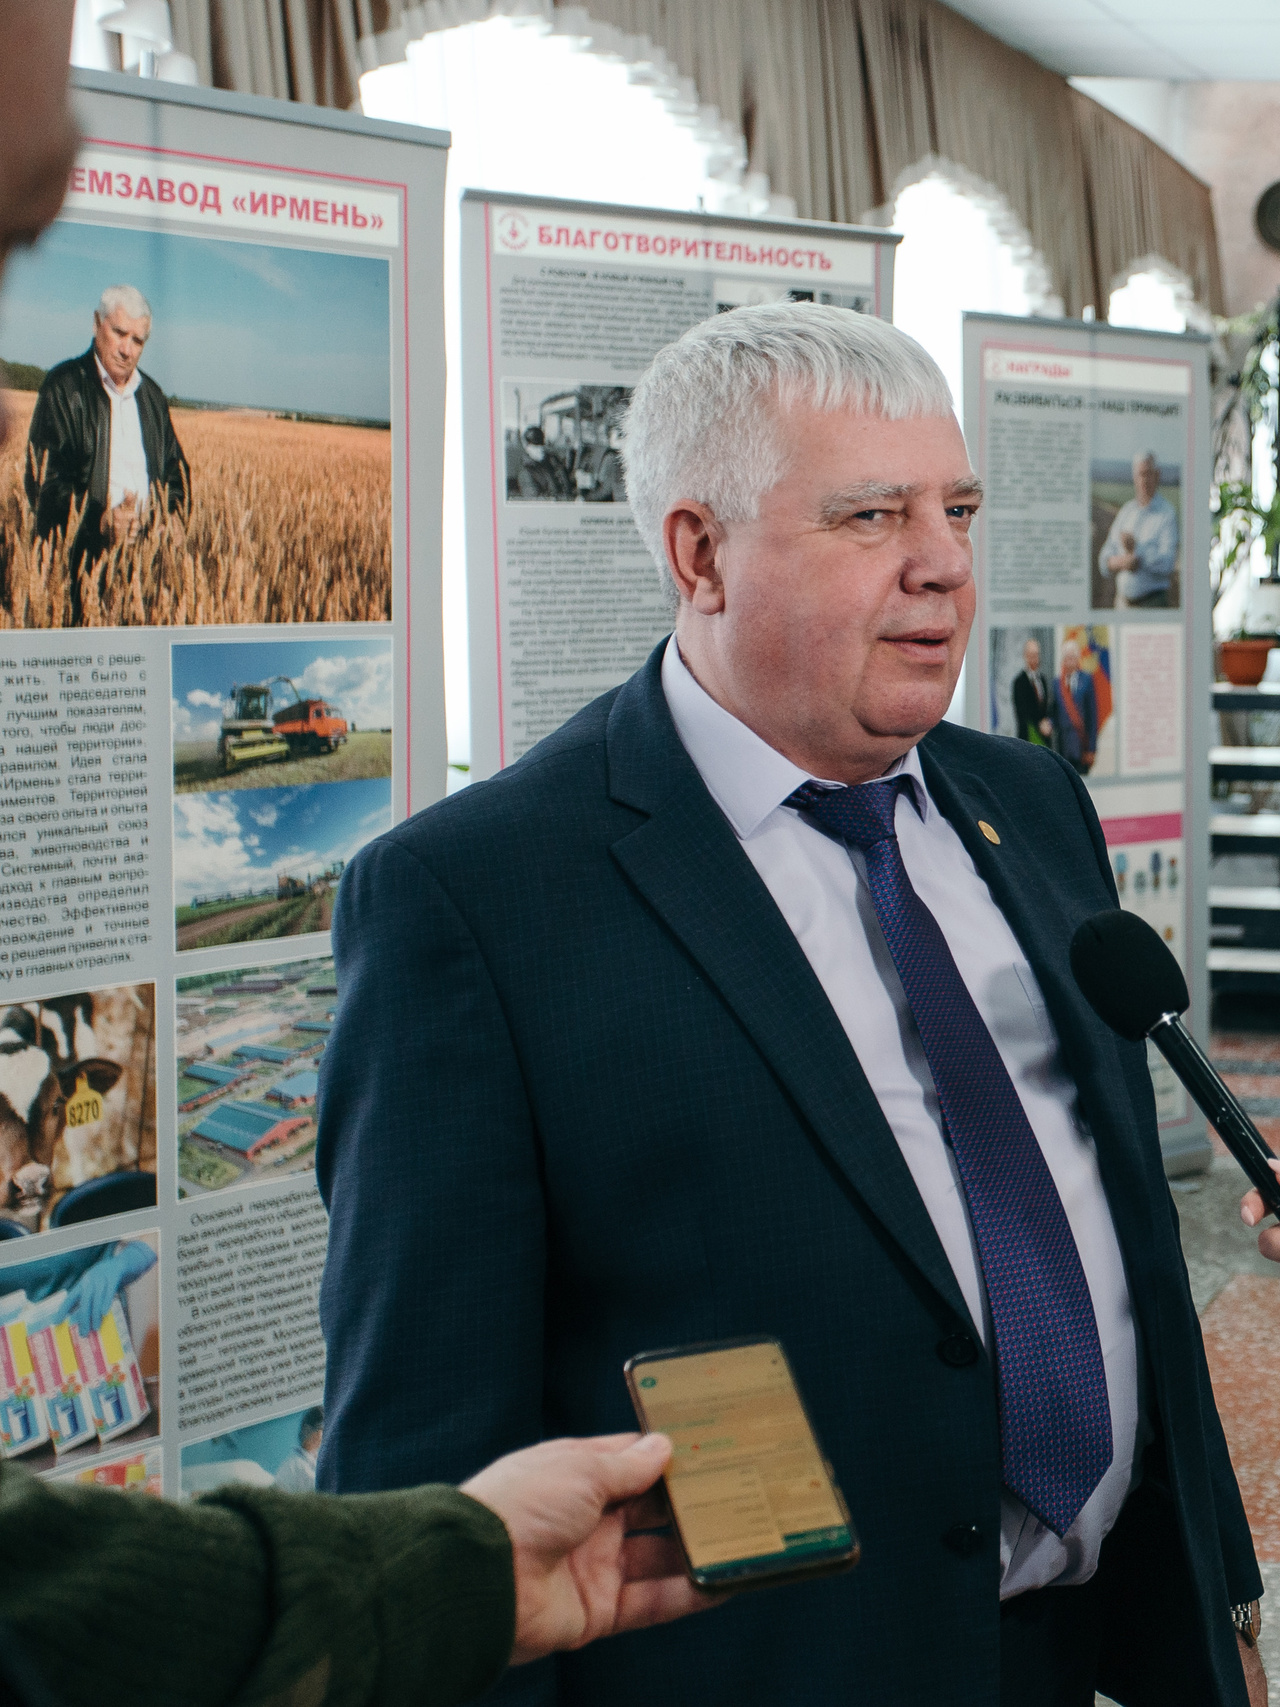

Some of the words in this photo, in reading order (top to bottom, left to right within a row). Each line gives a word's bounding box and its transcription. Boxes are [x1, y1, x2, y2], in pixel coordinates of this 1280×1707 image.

[232, 190, 384, 230] «ИРМЕНЬ»
[538, 226, 832, 271] БЛАГОТВОРИТЕЛЬНОСТЬ
[22, 655, 93, 669] начинается
[59, 669, 80, 684] Так
[91, 668, 128, 682] было
[59, 686, 147, 702] председателя
[6, 709, 58, 724] лучшим
[40, 721, 77, 736] чтобы
[82, 721, 115, 734] люди
[16, 742, 58, 756] нашей
[70, 755, 102, 769] Идея
[112, 752, 147, 766] стала
[67, 772, 101, 786] стала
[69, 785, 148, 802] Территорией
[18, 809, 60, 824] своего
[62, 806, 98, 821] опыта
[110, 801, 148, 816] опыта
[37, 820, 109, 843] уникальный
[118, 819, 148, 831] союз
[31, 836, 130, 858] животноводства
[82, 854, 117, 869] почти
[51, 872, 102, 890] главным
[78, 883, 149, 902] определил
[61, 900, 149, 921] Эффективное
[104, 916, 150, 932] точные
[11, 944, 67, 964] решения
[67, 936, 118, 955] привели
[25, 959, 74, 977] главных
